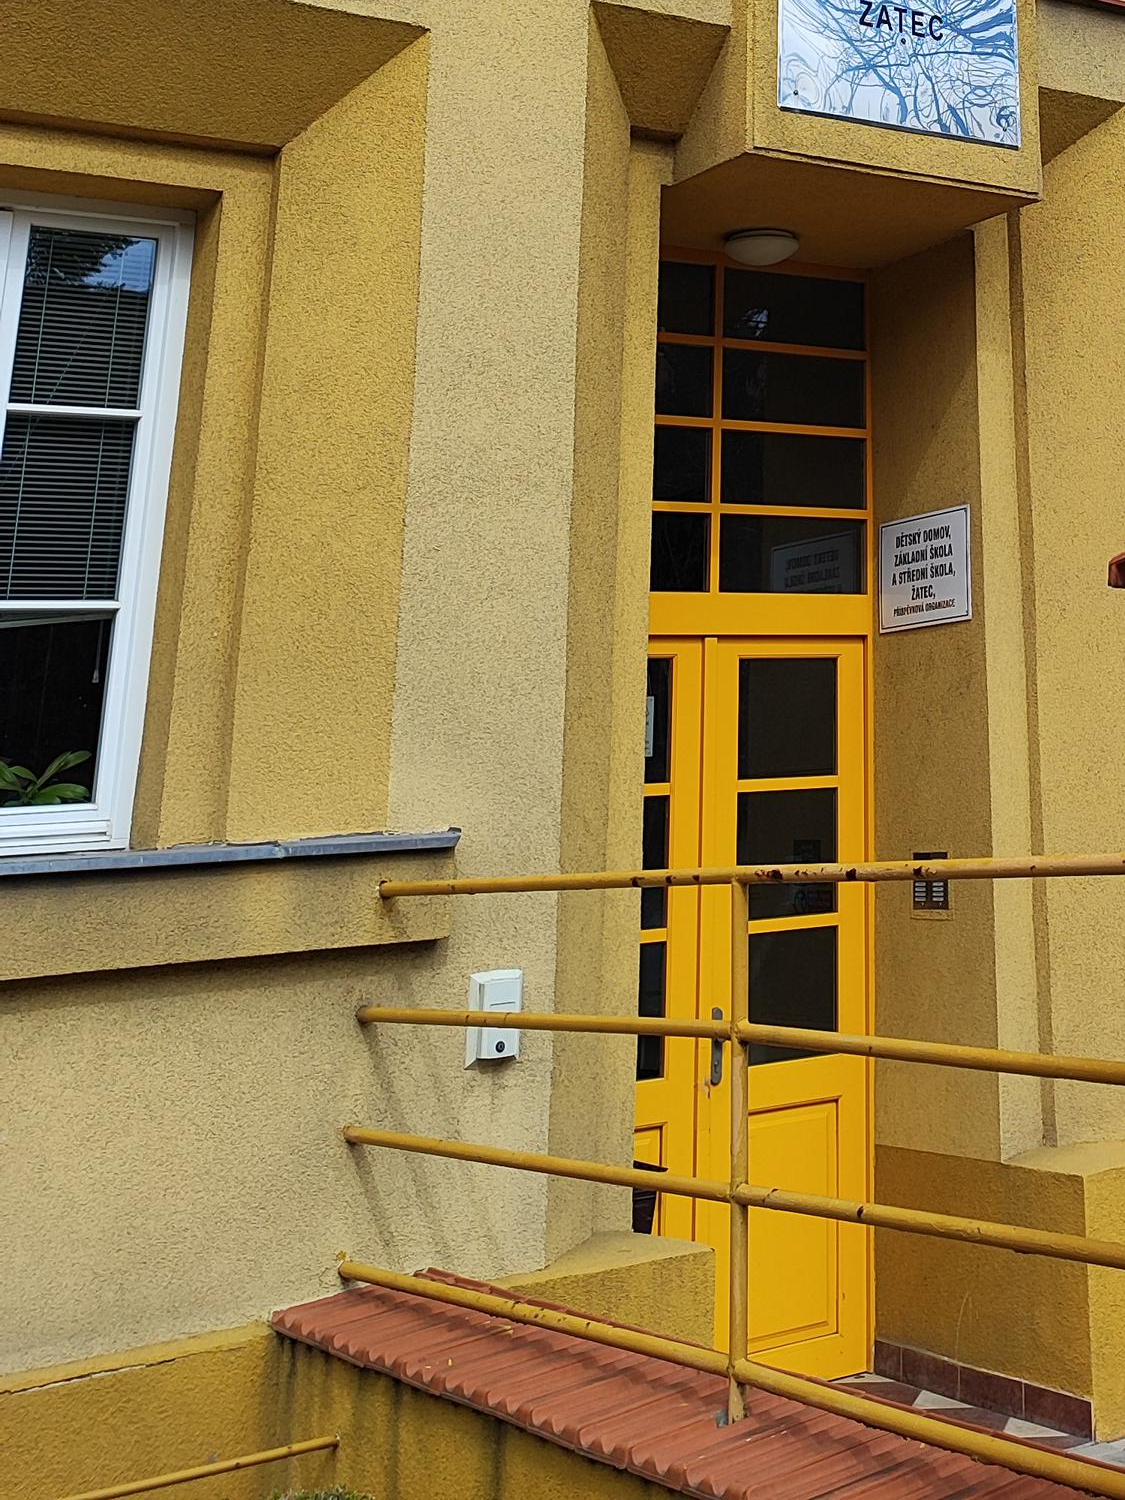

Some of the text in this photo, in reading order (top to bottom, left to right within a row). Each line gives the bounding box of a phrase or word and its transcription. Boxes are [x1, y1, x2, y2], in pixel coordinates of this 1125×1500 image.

[895, 524, 952, 548] DĚTSKÝ DOMOV,
[894, 543, 953, 567] ZÁKLADNÍ ŠKOLA
[891, 561, 956, 586] A STŘEDNÍ ŠKOLA,
[911, 585, 936, 601] ŽATEC,
